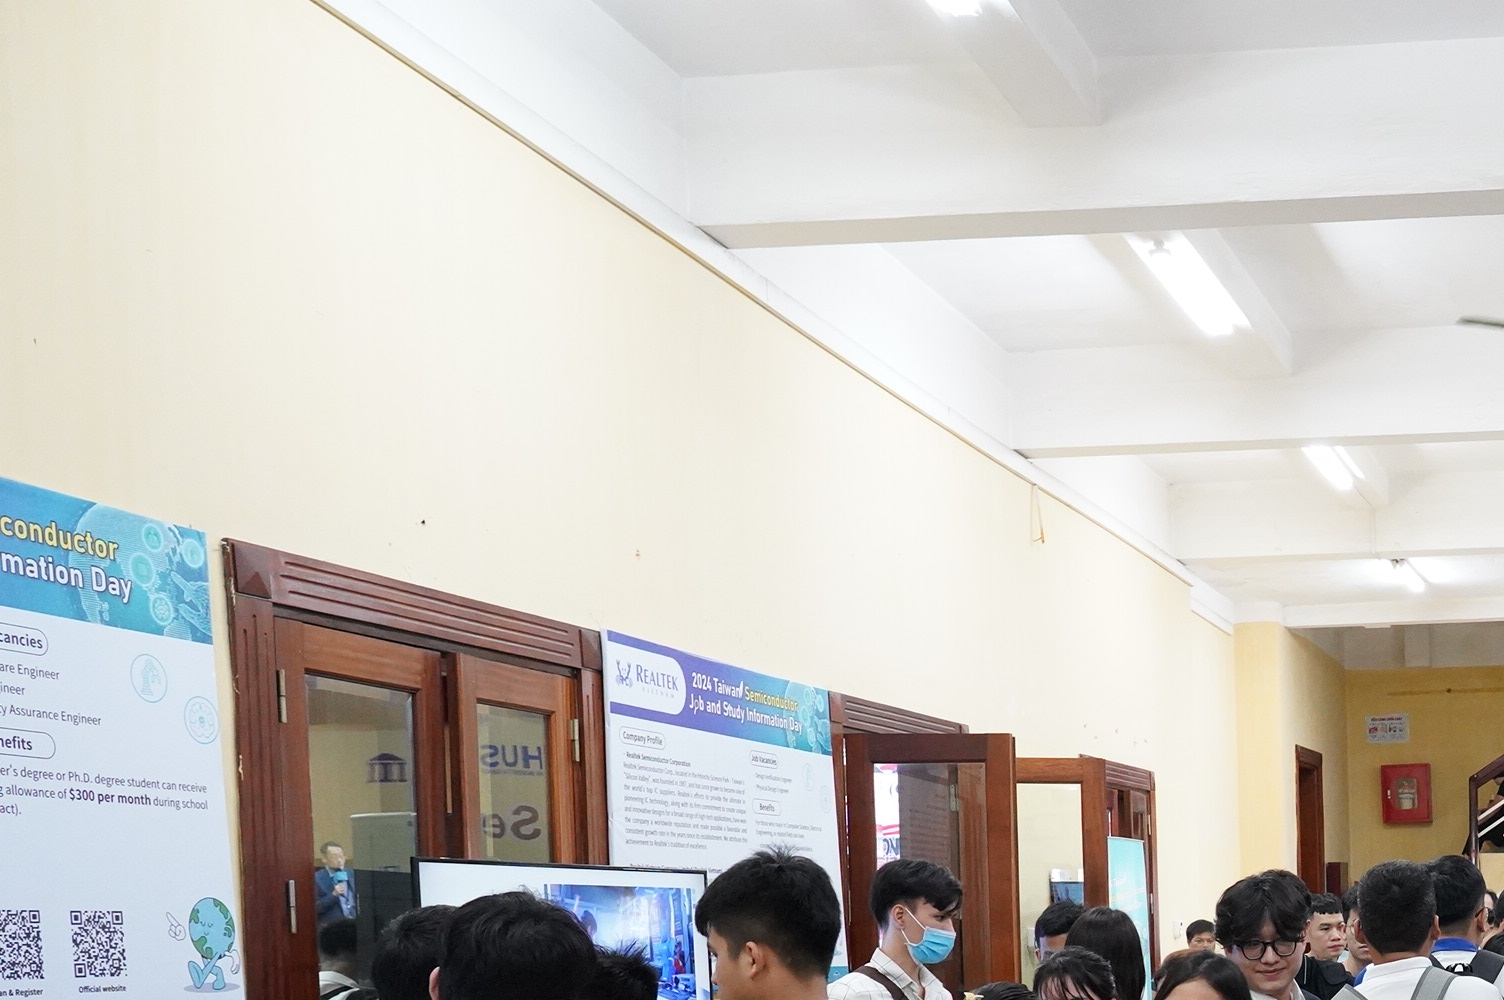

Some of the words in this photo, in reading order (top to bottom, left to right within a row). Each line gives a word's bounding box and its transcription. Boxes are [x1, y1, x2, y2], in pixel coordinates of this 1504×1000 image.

[0, 515, 119, 560] conductor
[1, 552, 84, 589] mation
[91, 565, 132, 604] Day
[18, 664, 60, 680] Engineer
[692, 672, 712, 692] 2024
[714, 677, 741, 698] Taiwan
[745, 686, 798, 712] Semiconductor
[9, 705, 59, 720] Assurance
[61, 711, 102, 726] Engineer
[707, 700, 721, 715] and
[723, 703, 745, 723] Study
[746, 707, 788, 730] Information
[789, 718, 803, 735] Day
[623, 731, 646, 744] Company
[647, 735, 663, 746] Profile
[20, 767, 54, 781] degree
[56, 771, 66, 781] or
[68, 771, 93, 784] Ph.D.
[95, 774, 125, 788] degree
[127, 778, 160, 789] student
[162, 782, 177, 791] can
[178, 784, 207, 793] receive
[6, 784, 55, 799] allowance
[58, 788, 67, 800] of
[69, 788, 95, 802] $300
[98, 793, 115, 804] per
[118, 794, 151, 806] month
[153, 797, 181, 810] during
[182, 800, 208, 810] school
[759, 802, 775, 813] Benefits
[15, 988, 43, 997] Register
